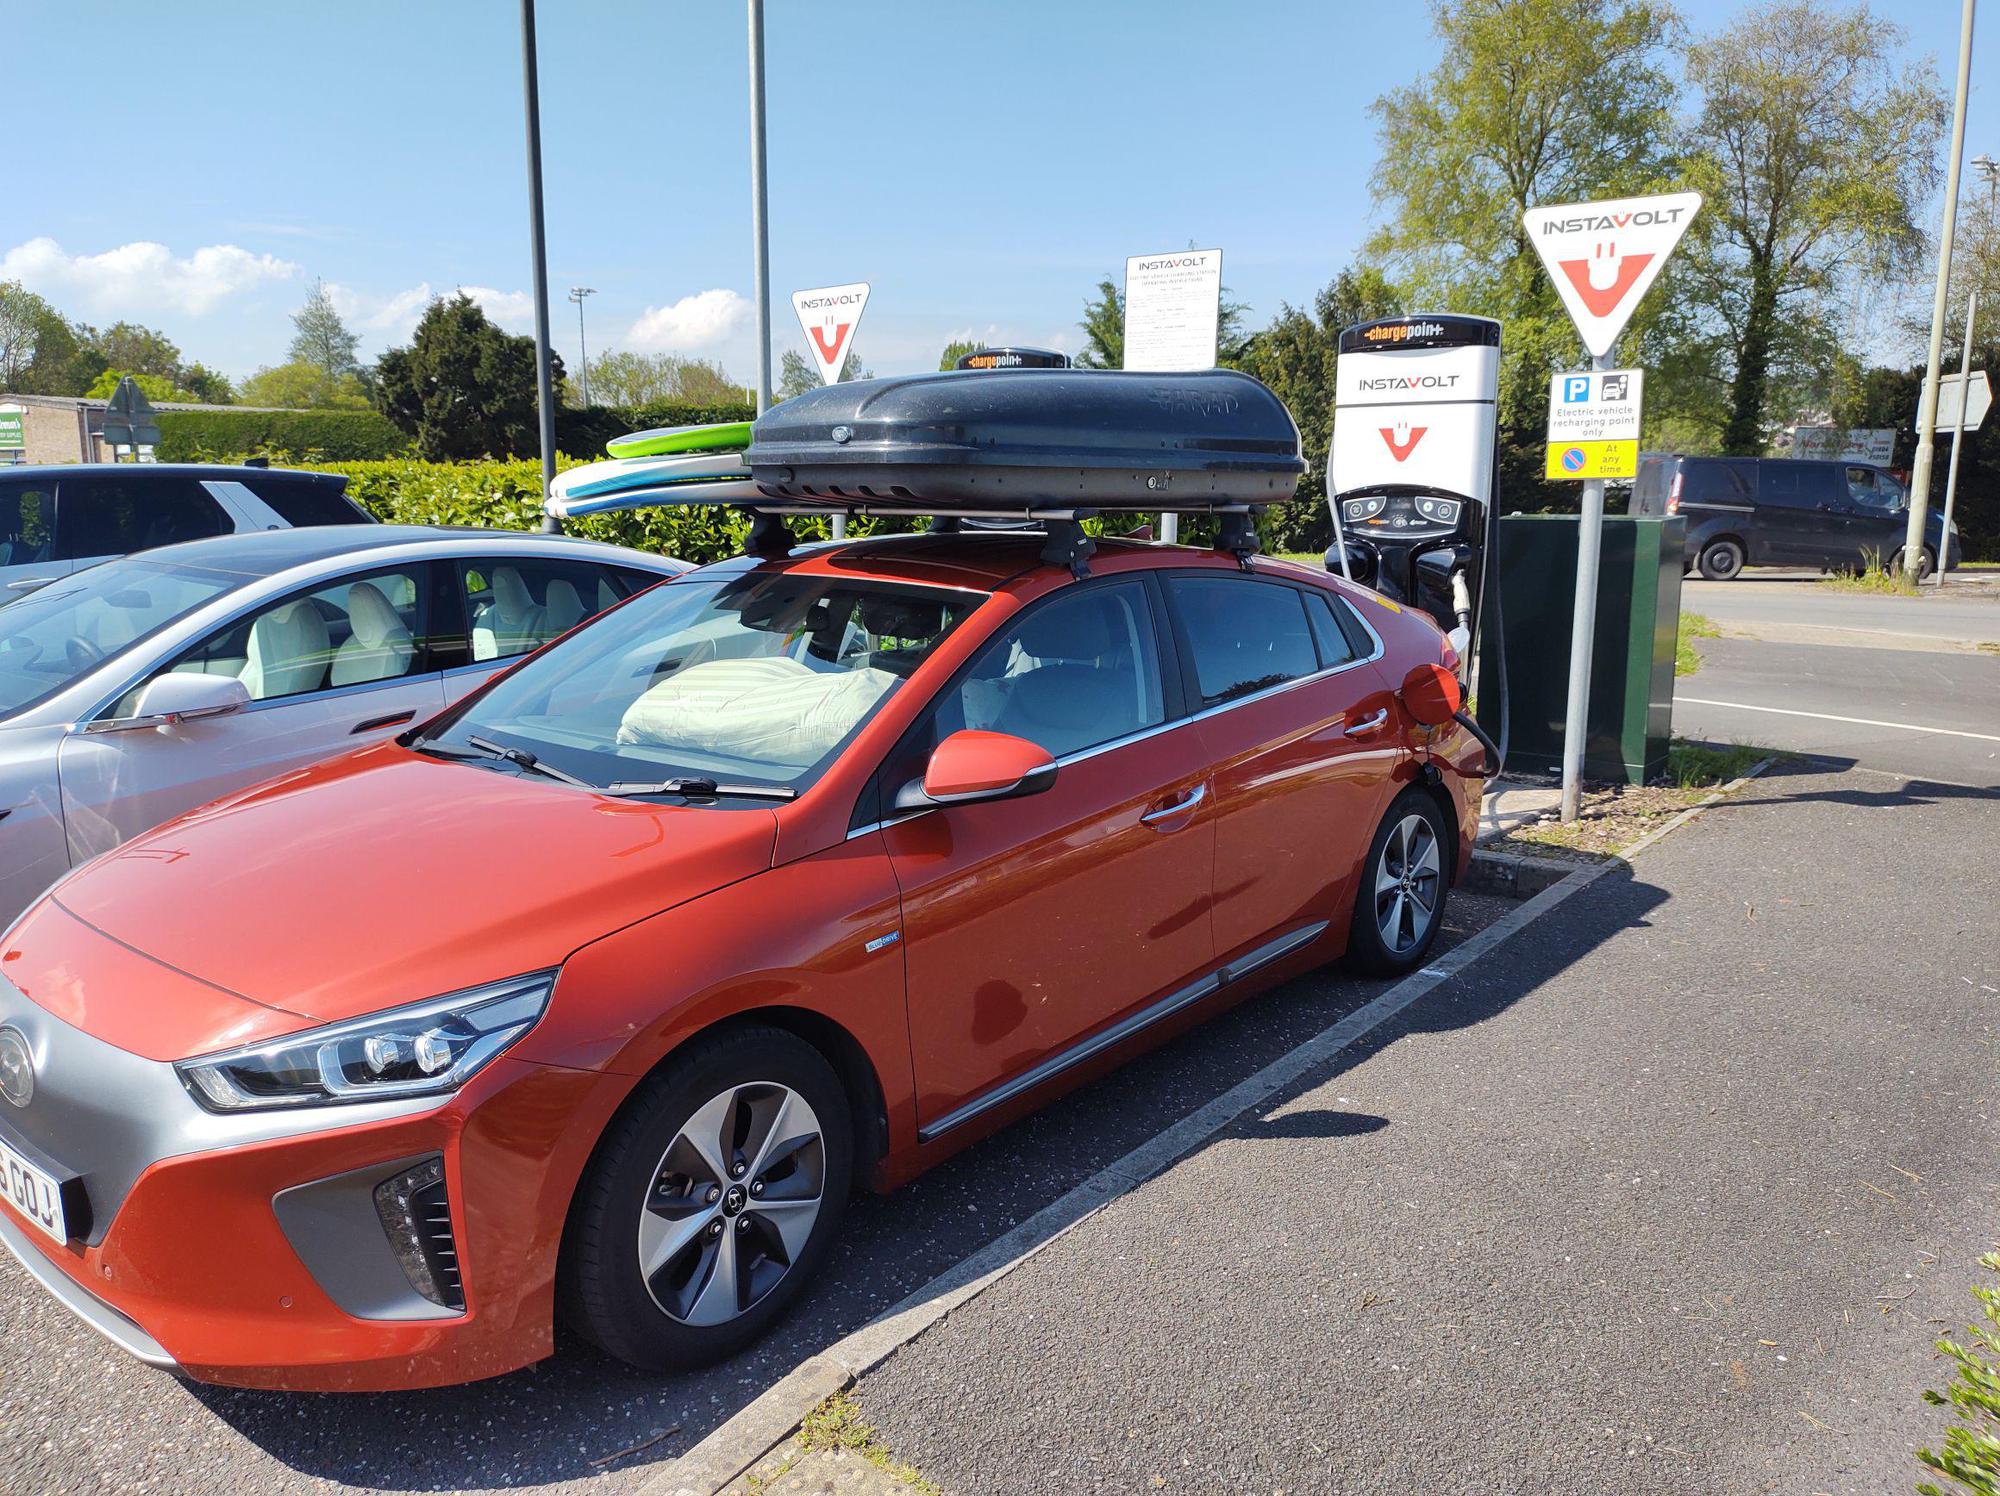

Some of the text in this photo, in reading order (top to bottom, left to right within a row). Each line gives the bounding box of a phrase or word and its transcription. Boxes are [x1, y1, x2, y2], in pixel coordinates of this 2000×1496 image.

[1543, 208, 1685, 235] INSTAVOLT
[1138, 257, 1207, 271] INSTAVOLT
[801, 293, 862, 310] INSTAVOLT
[1359, 375, 1460, 391] INSTAVOLT
[1569, 379, 1587, 401] P
[1557, 406, 1633, 417] Electric vehicle
[1553, 417, 1635, 427] recharging point
[1582, 429, 1604, 437] only
[1606, 444, 1618, 453] At
[1602, 456, 1620, 464] any
[1600, 466, 1622, 474] time
[9, 1159, 54, 1228] GOJ
